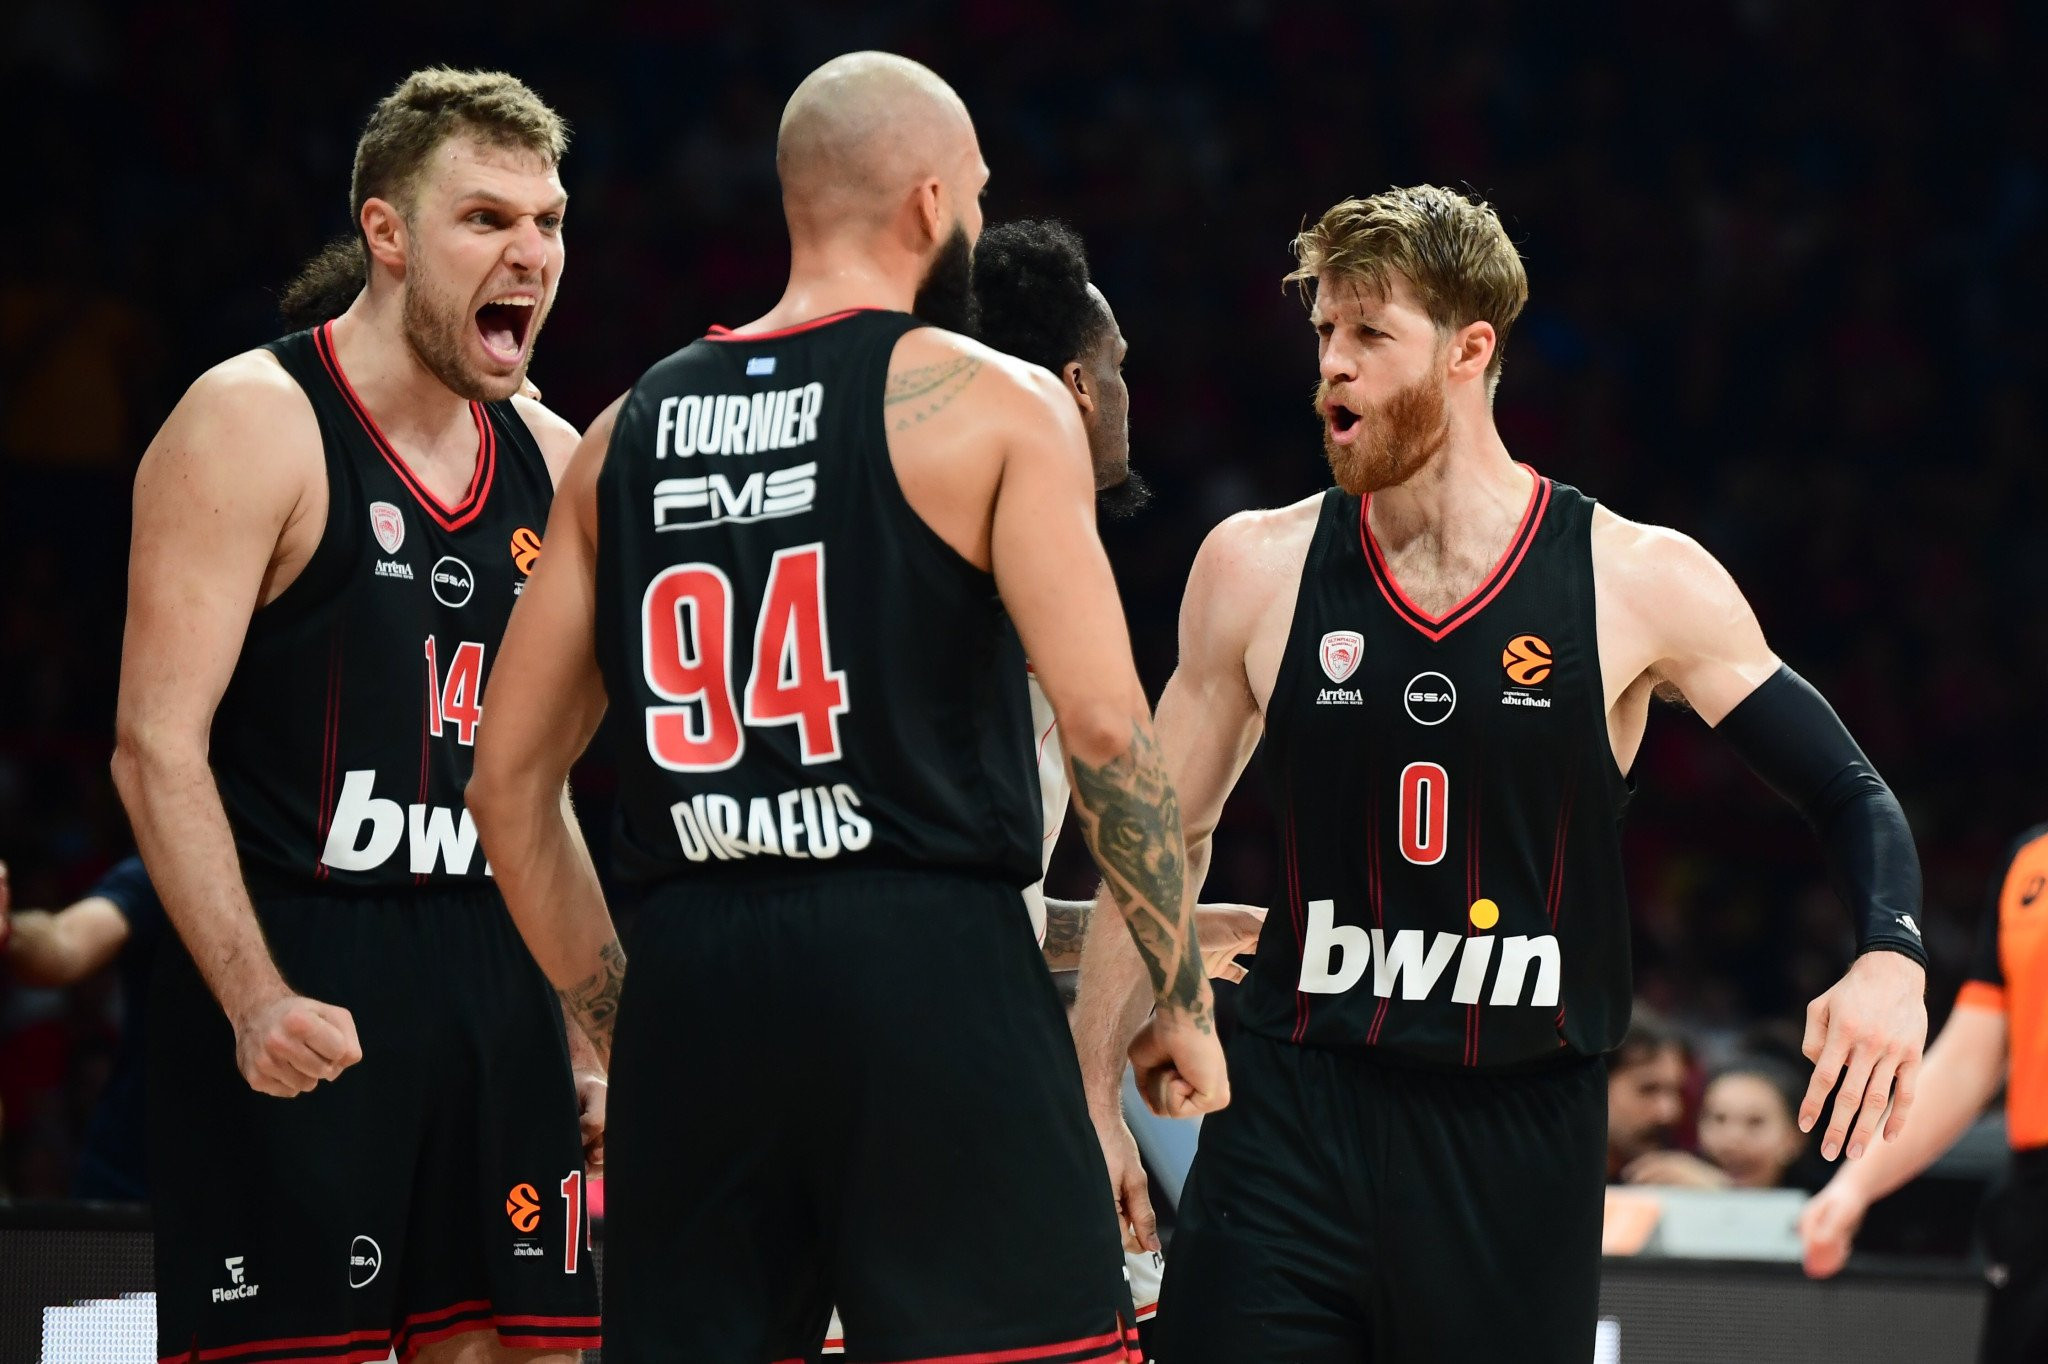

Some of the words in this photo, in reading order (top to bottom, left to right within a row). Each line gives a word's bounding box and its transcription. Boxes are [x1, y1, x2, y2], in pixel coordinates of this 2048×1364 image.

[656, 381, 824, 460] FOURNIER
[653, 461, 818, 527] FMS
[425, 634, 482, 746] 14
[641, 541, 849, 773] 94
[1408, 692, 1452, 702] GSA
[1501, 695, 1521, 706] abu
[1522, 697, 1551, 708] dhabi
[320, 769, 493, 876] bw
[1399, 762, 1449, 866] 0
[1298, 899, 1561, 1007] bwin
[212, 1284, 259, 1303] FlexCar
